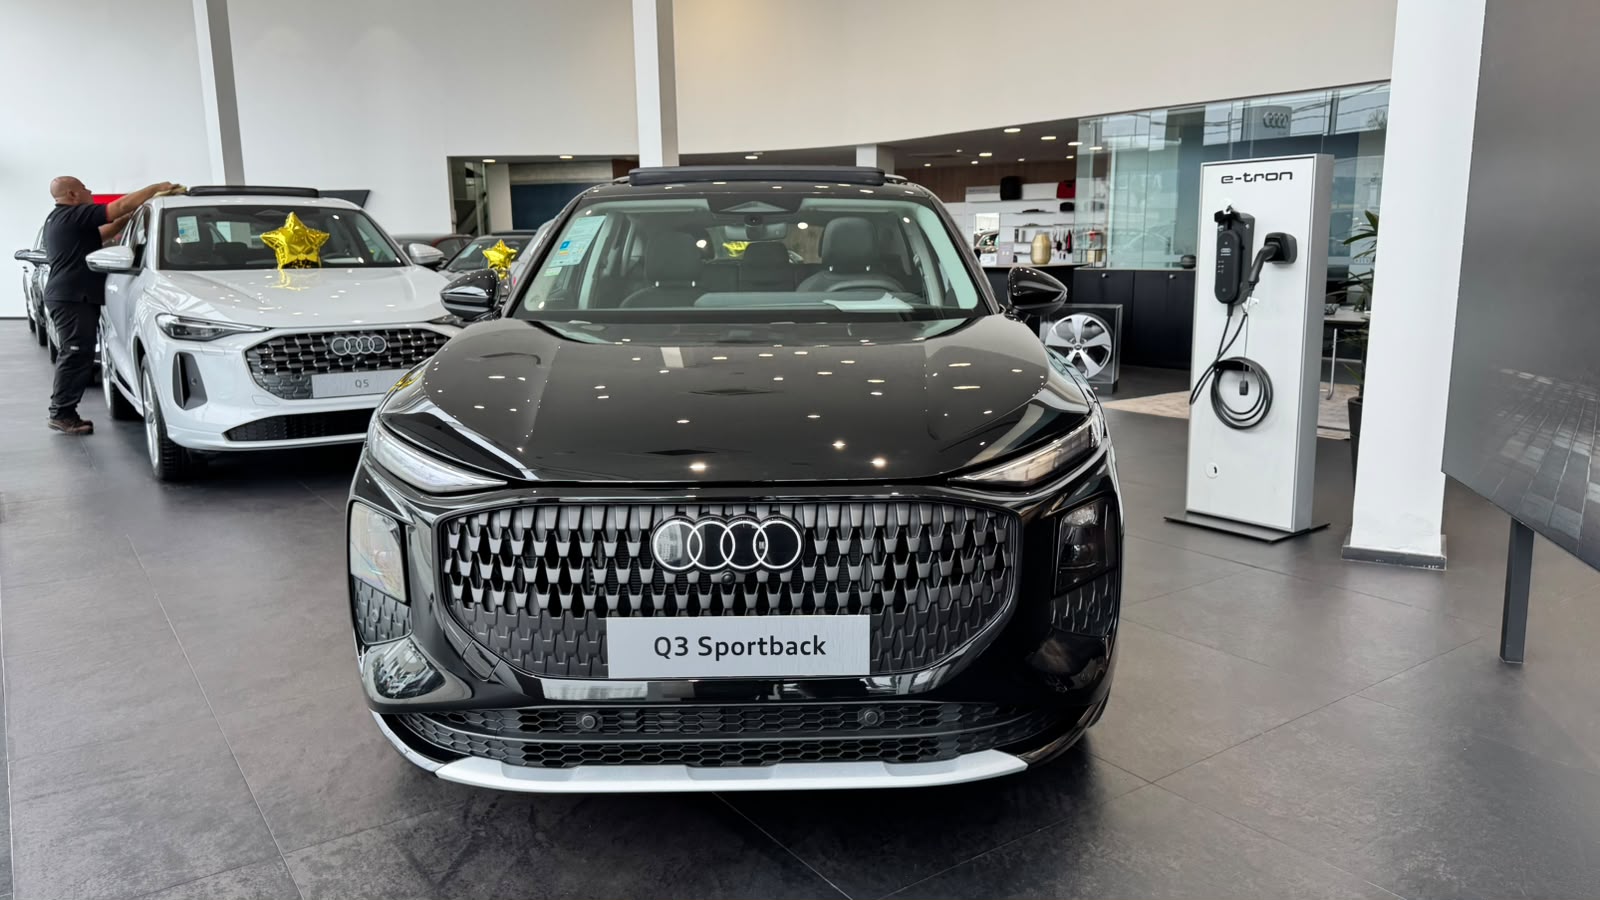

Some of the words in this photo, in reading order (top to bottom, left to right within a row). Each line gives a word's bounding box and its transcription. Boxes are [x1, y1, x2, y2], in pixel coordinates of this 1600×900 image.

[1221, 171, 1293, 184] e-tron
[354, 379, 370, 389] Q5
[653, 636, 689, 659] Q3
[697, 635, 827, 661] Sportback
